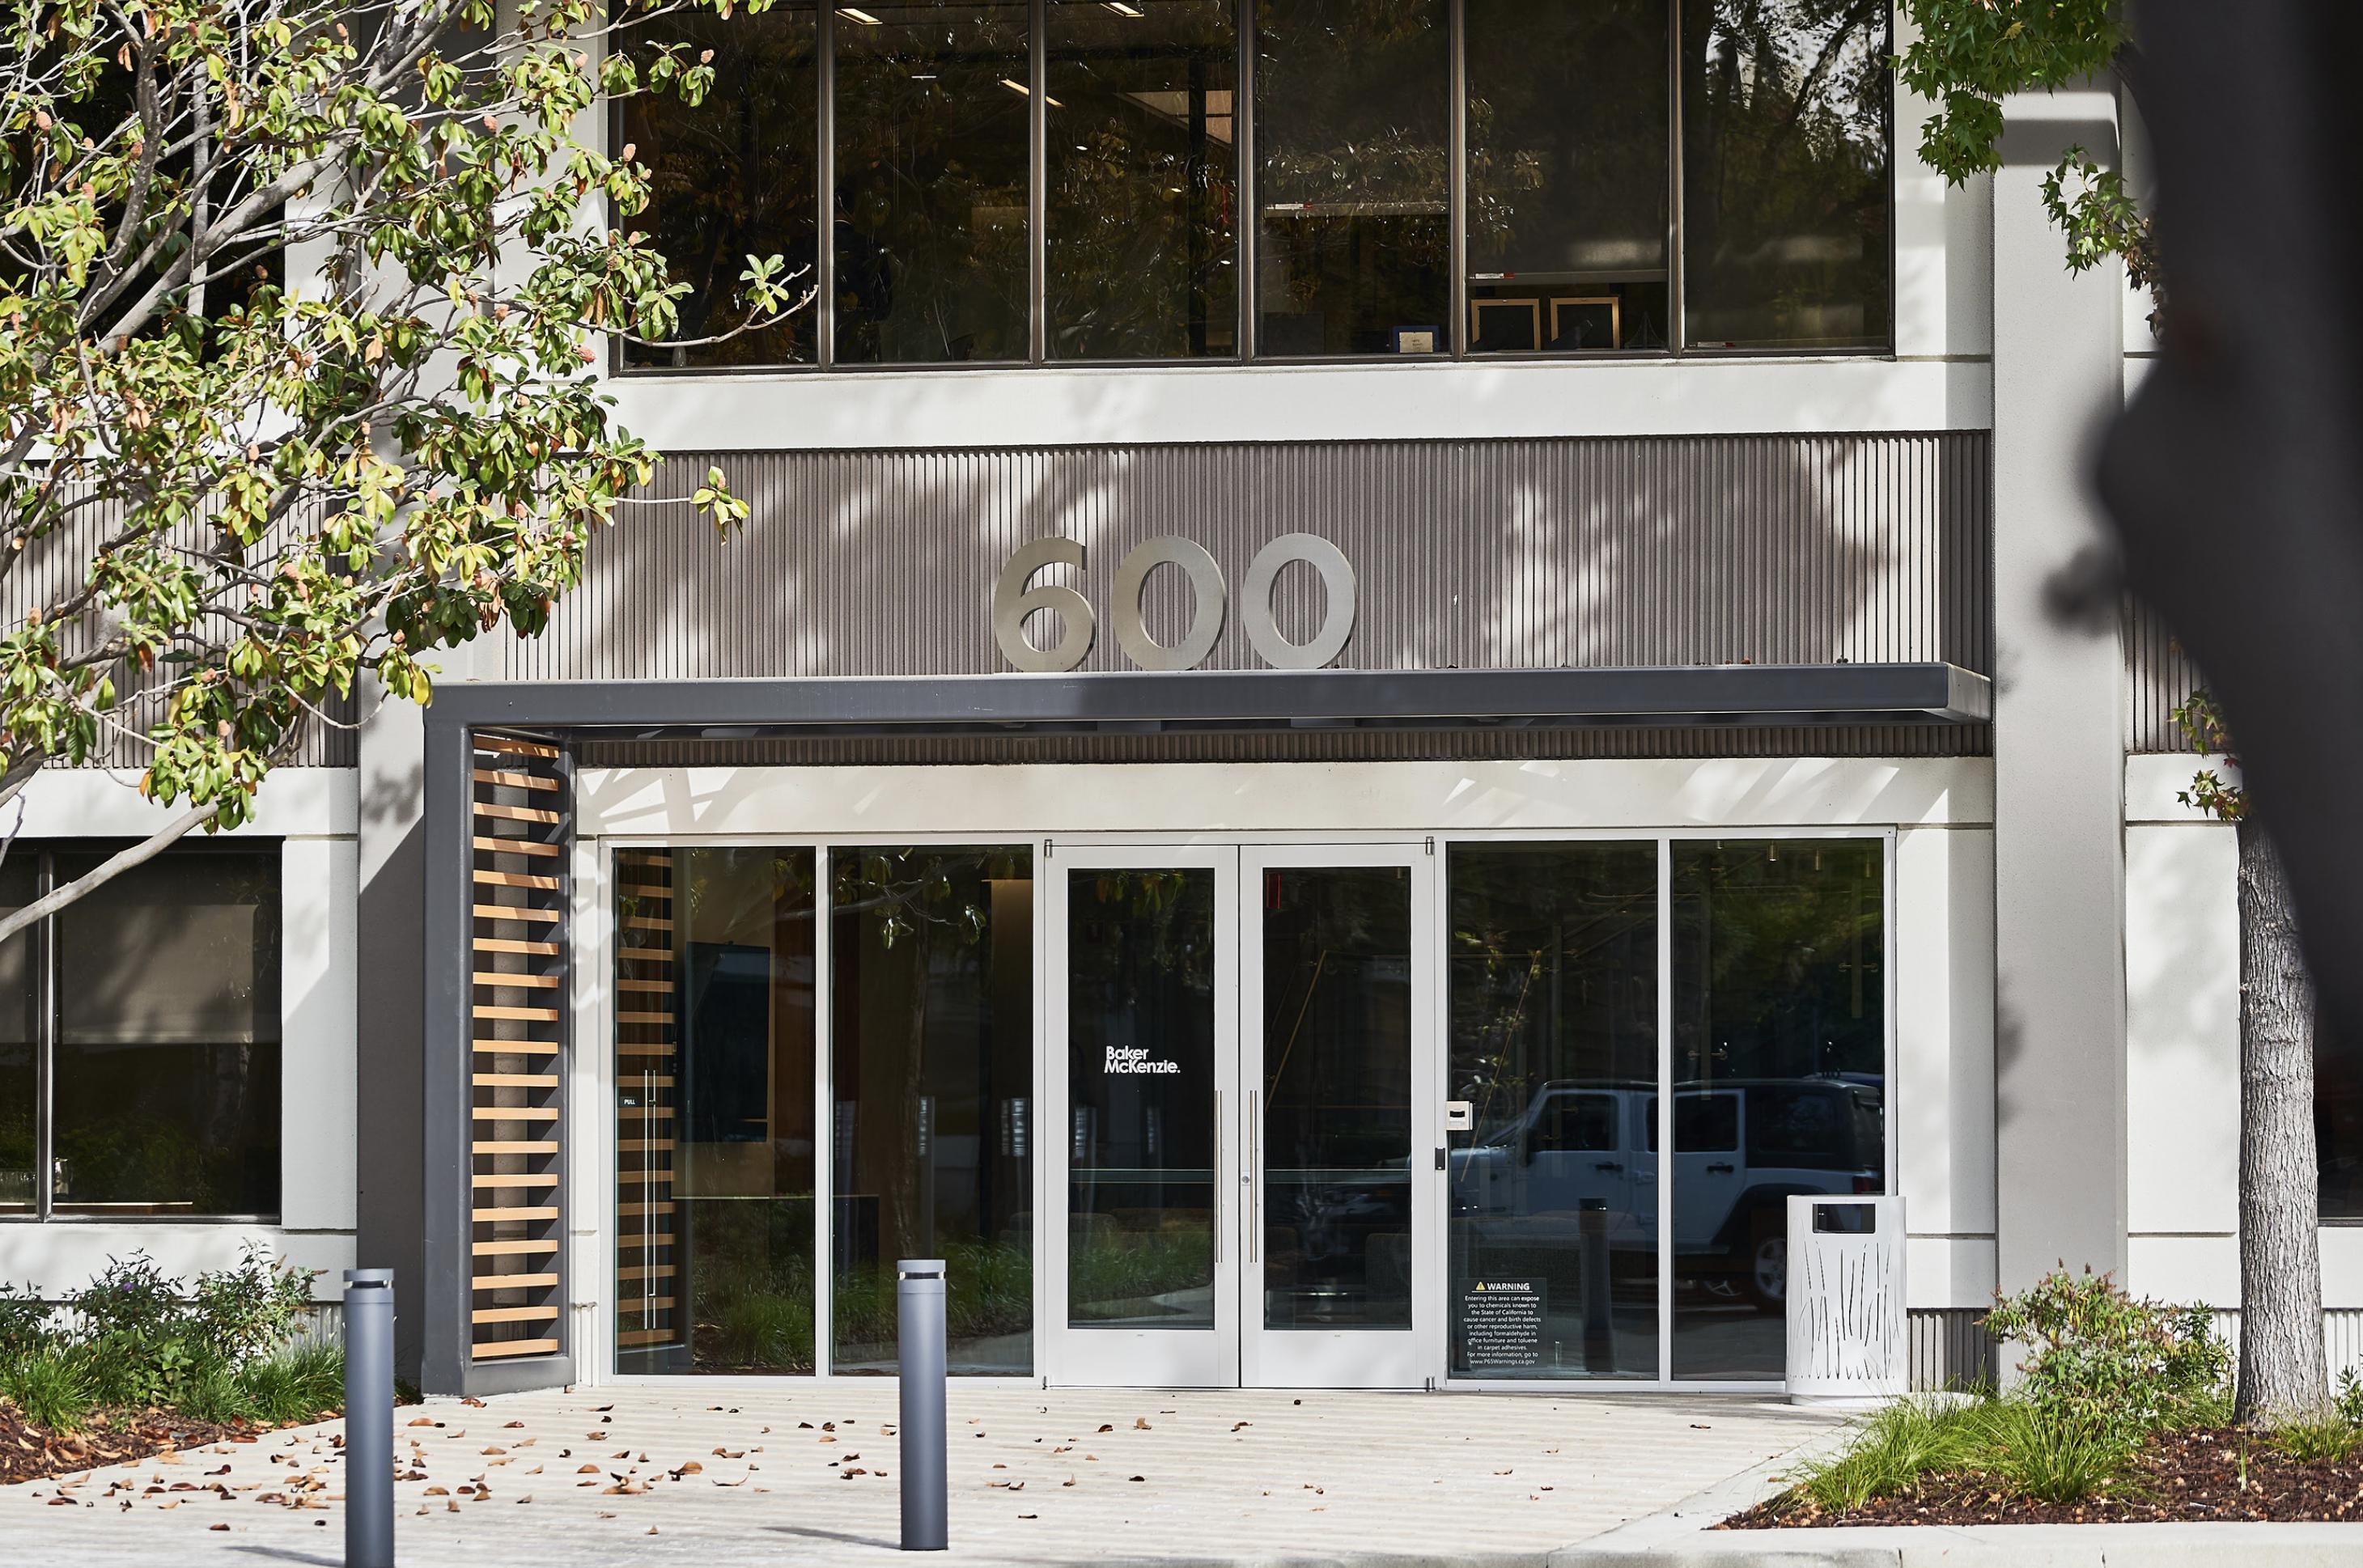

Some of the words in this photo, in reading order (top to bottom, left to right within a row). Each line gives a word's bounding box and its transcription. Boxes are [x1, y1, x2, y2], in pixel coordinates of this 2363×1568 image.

[994, 532, 1358, 672] 600
[1106, 1045, 1149, 1060] Baker
[1104, 1059, 1181, 1073] McKenzie.
[1487, 1282, 1530, 1290] WARNING
